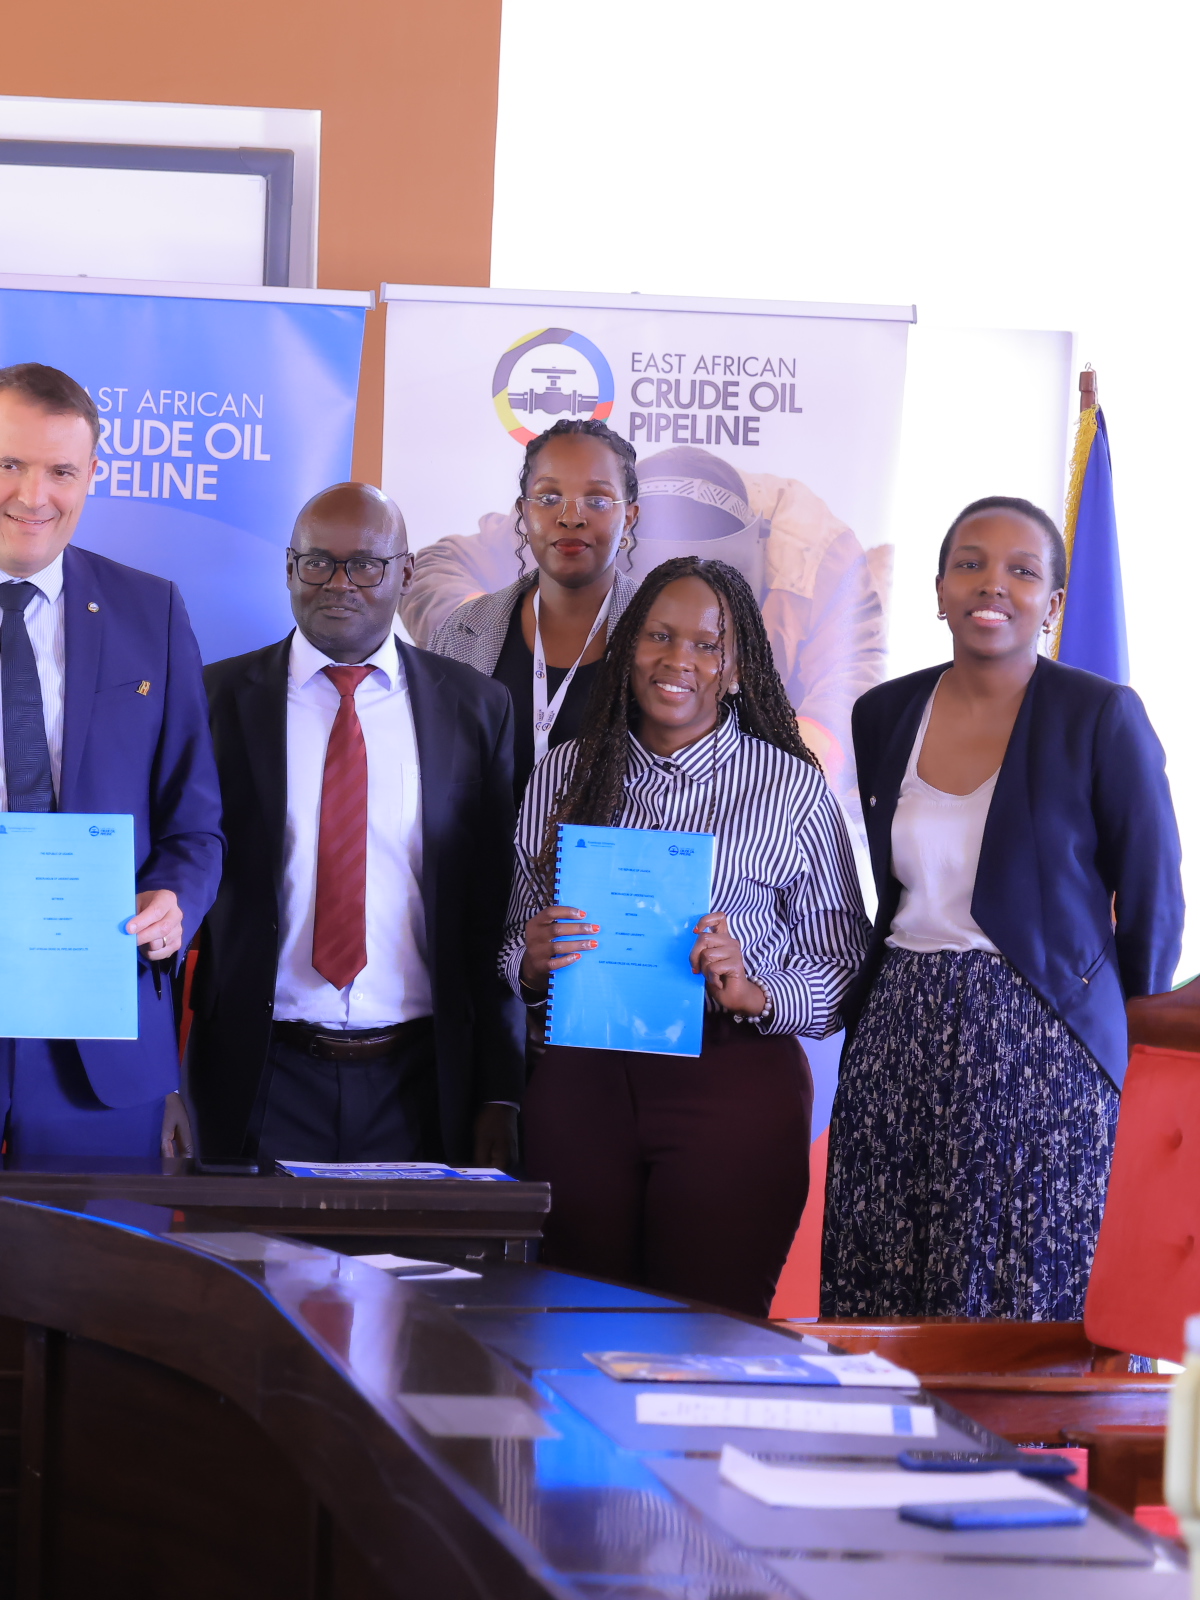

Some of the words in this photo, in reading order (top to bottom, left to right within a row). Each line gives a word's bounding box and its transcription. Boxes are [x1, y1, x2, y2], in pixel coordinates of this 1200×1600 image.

[631, 352, 686, 374] EAST
[693, 354, 796, 378] AFRICAN
[136, 388, 264, 419] AFRICAN
[631, 377, 740, 410] CRUDE
[749, 381, 803, 413] OIL
[98, 417, 194, 457] RUDE
[205, 422, 271, 461] OIL
[629, 412, 760, 446] PIPELINE
[88, 460, 218, 500] PELINE
